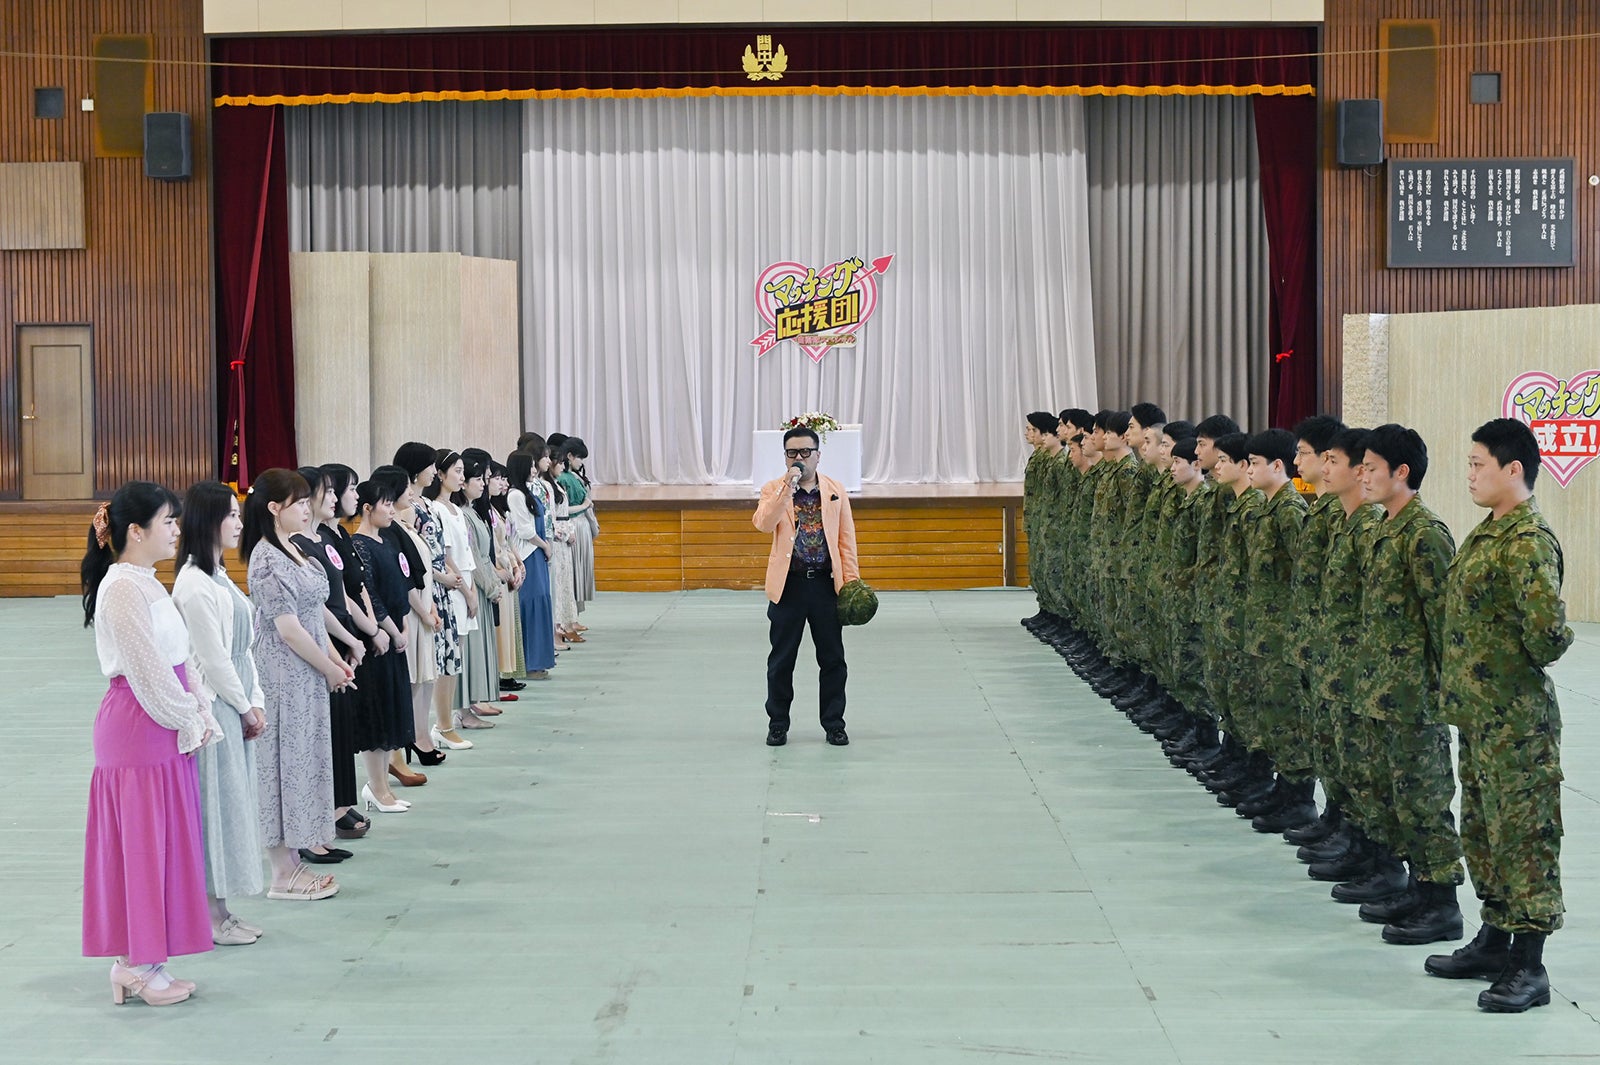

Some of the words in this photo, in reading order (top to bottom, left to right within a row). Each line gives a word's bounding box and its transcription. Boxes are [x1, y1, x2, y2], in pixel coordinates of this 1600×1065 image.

[764, 256, 864, 306] マッチング
[777, 293, 858, 339] 応援団!
[1533, 423, 1597, 453] 成立!
